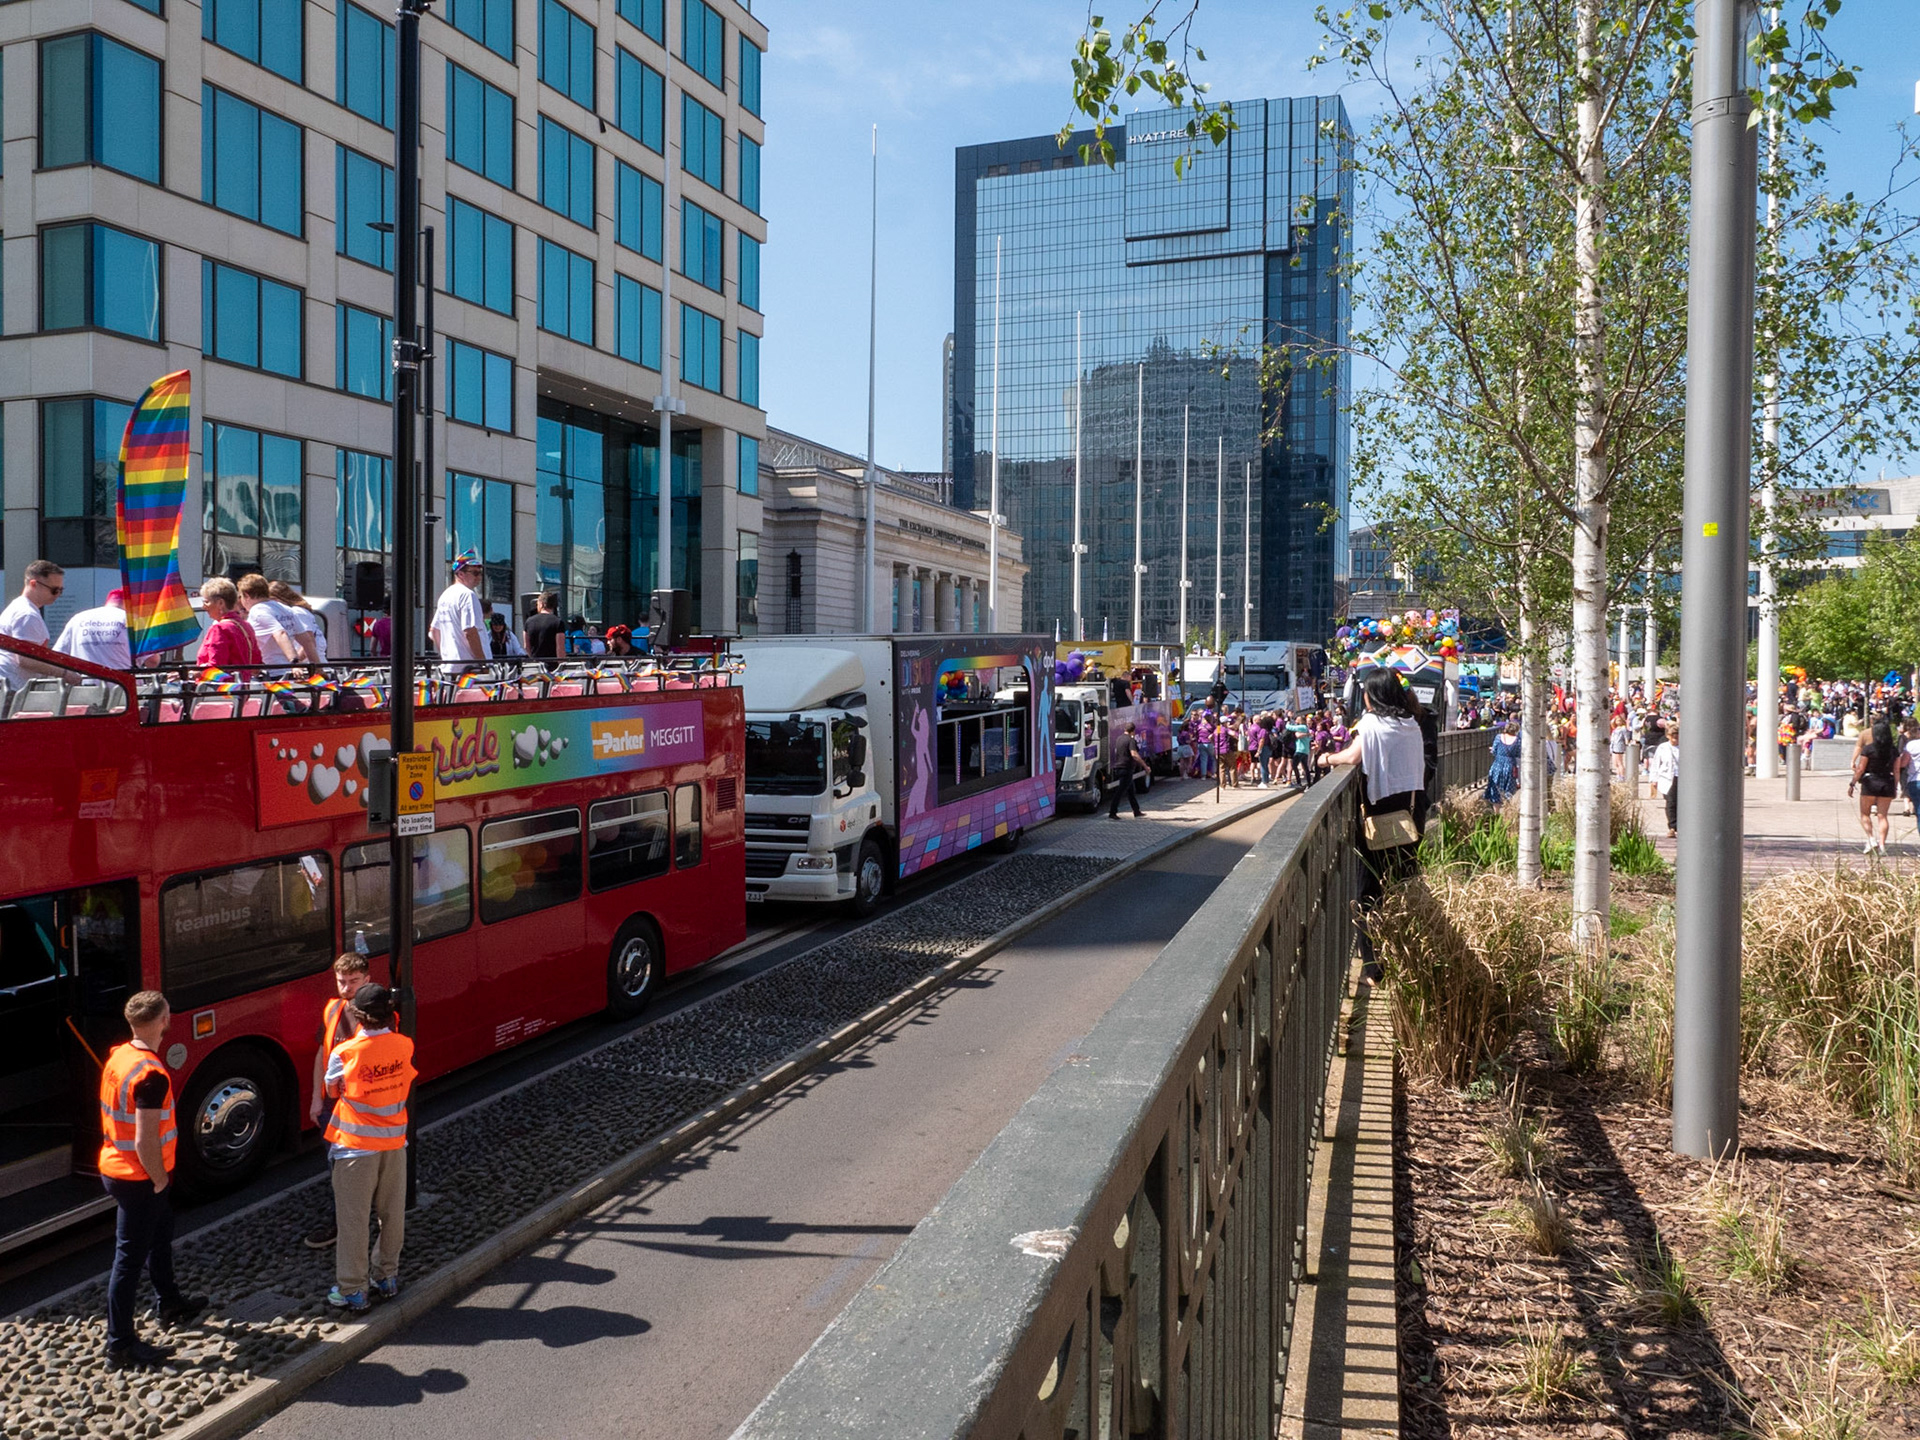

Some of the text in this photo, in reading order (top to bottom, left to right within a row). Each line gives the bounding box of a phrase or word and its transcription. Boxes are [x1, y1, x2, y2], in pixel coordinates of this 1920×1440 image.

[1129, 130, 1167, 144] HYATT
[1851, 494, 1880, 509] ICC
[82, 629, 122, 638] Diversity
[1043, 650, 1055, 672] dpd
[593, 731, 644, 753] Parker
[414, 717, 500, 784] ride
[402, 755, 431, 763] Restricted
[411, 815, 432, 824] loading
[420, 823, 433, 831] time
[175, 906, 251, 933] teambus
[373, 1060, 403, 1078] Knight
